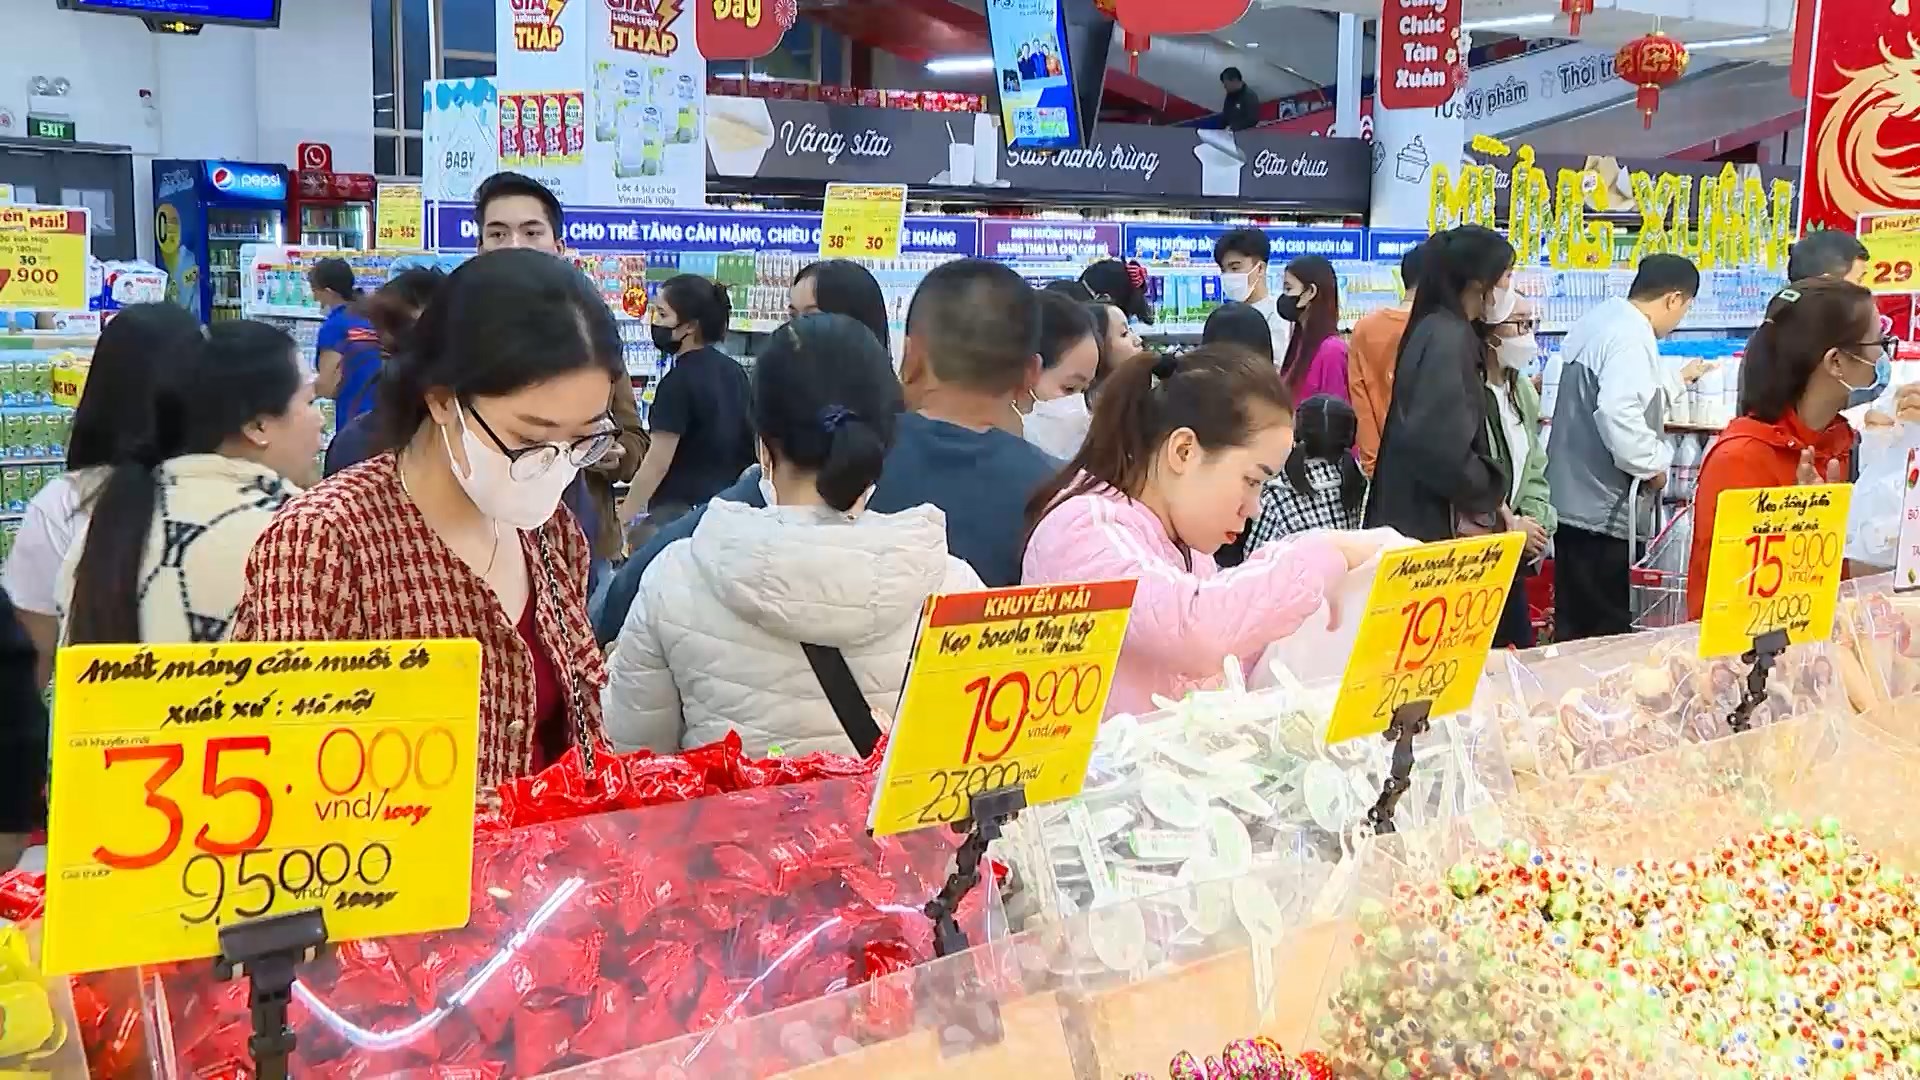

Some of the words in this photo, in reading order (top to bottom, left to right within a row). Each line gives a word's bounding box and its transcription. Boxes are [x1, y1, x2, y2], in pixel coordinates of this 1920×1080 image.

[1399, 12, 1446, 35] Chúc
[1403, 42, 1438, 62] Tân
[1395, 67, 1446, 88] Xuân
[1486, 76, 1528, 114] phẩm
[39, 122, 66, 138] EXIT
[850, 129, 892, 157] sữa
[445, 151, 476, 170] BABY
[1108, 143, 1160, 181] trùng
[1252, 148, 1288, 178] Sữa
[1290, 151, 1329, 178] chua
[240, 172, 281, 188] pepsi
[569, 223, 605, 241] CHO
[640, 222, 682, 243] TĂNG
[684, 222, 717, 242] CÂN
[912, 228, 957, 248] KHÁNG
[828, 235, 845, 249] 38
[865, 236, 884, 250] 30
[1286, 239, 1305, 252] CHO
[983, 587, 1058, 618] KHUYẾN
[1058, 585, 1091, 611] MÃI
